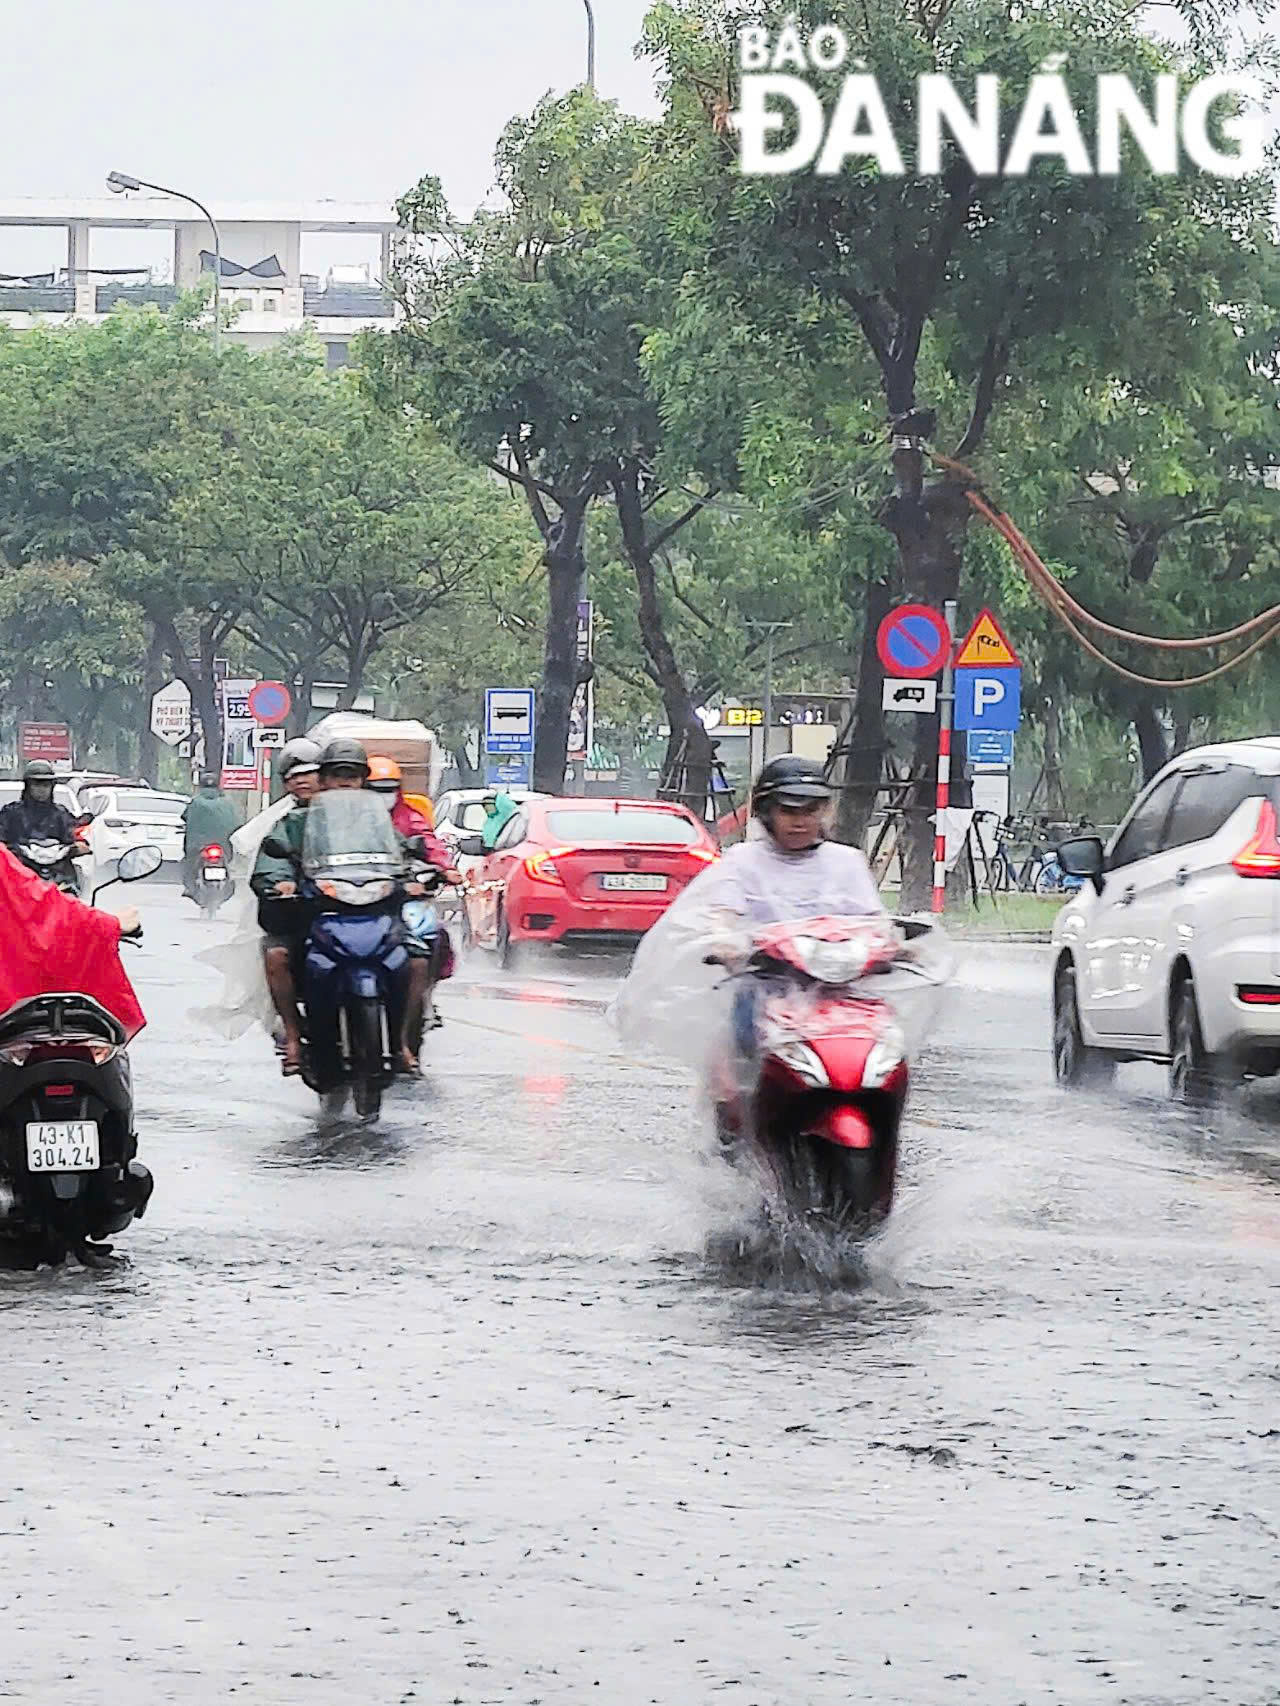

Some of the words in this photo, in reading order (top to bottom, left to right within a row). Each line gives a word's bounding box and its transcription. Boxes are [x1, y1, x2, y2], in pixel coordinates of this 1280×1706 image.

[973, 678, 1005, 716] P
[39, 1124, 86, 1145] 43-K1
[32, 1146, 94, 1168] 304.24
